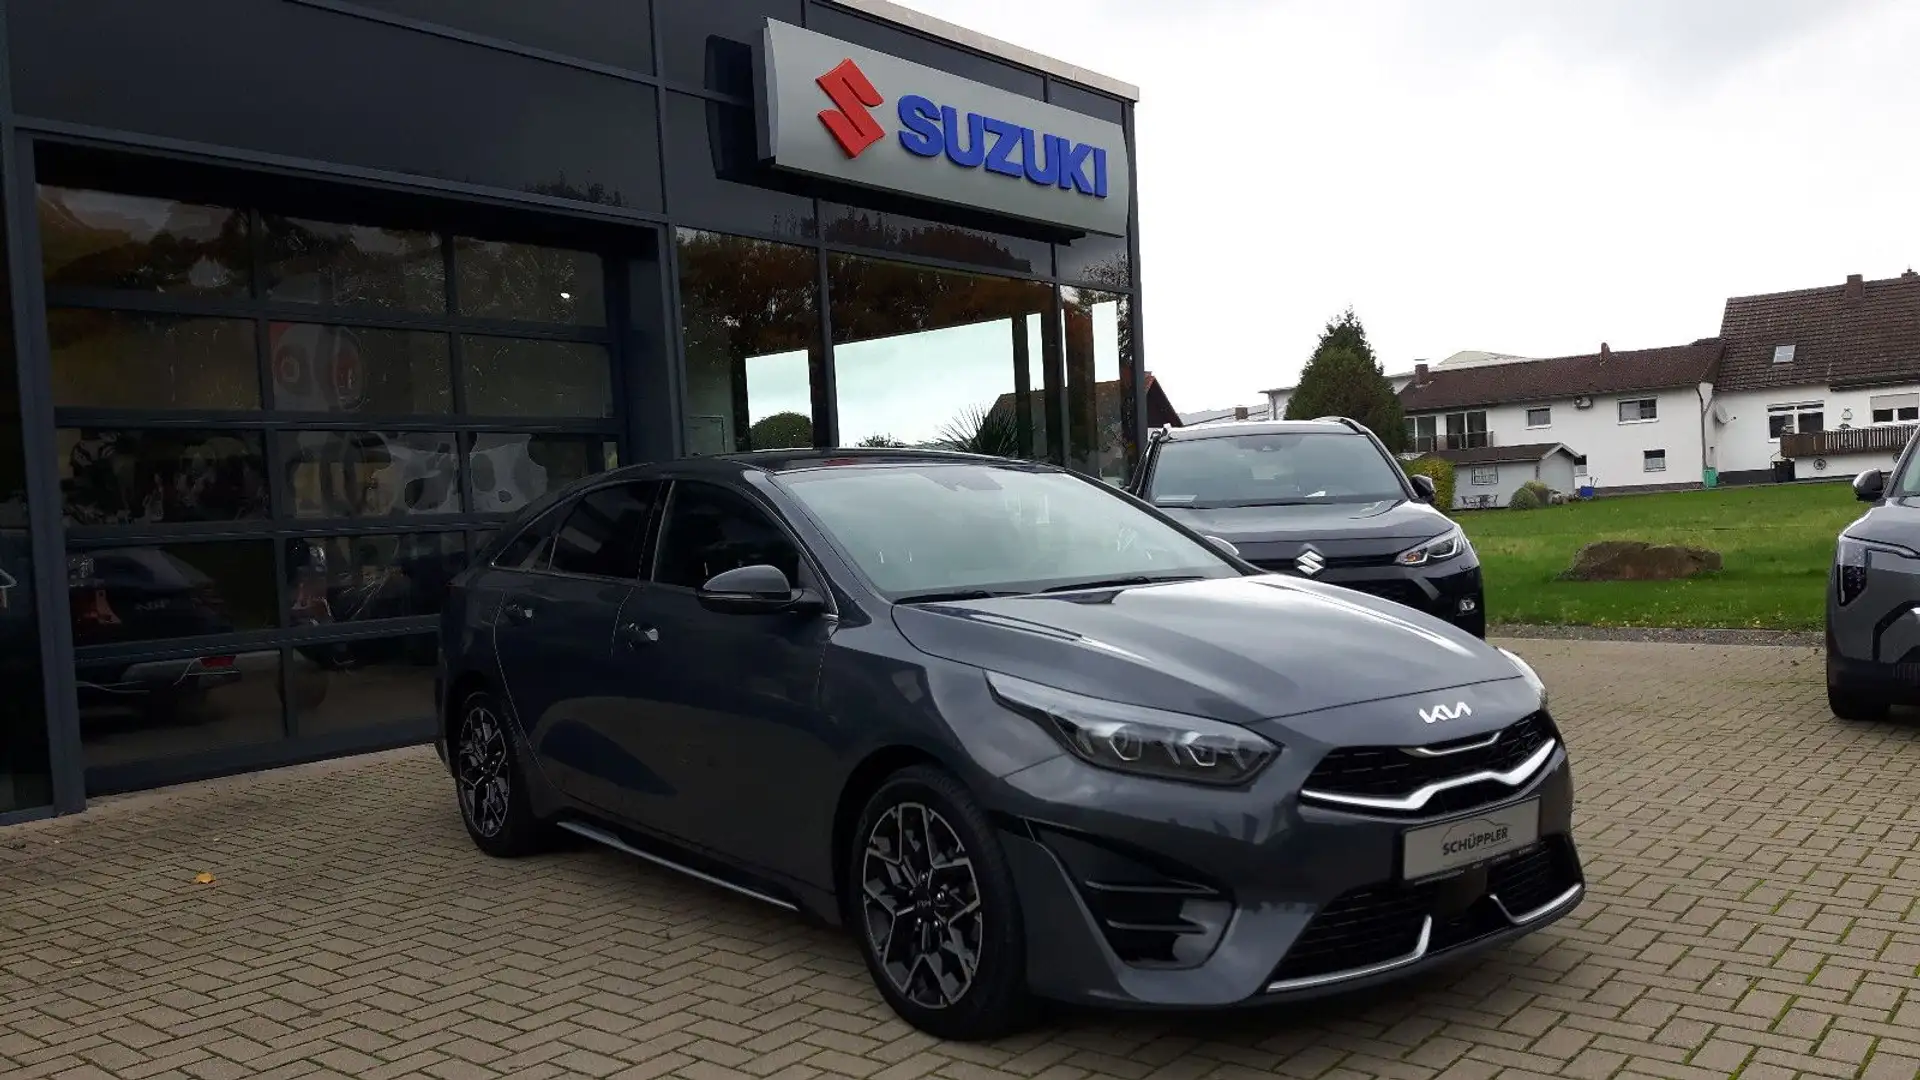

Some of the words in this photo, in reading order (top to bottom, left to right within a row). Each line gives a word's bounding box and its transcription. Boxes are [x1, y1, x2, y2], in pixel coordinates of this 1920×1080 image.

[897, 94, 1107, 197] SUZUKI
[1419, 702, 1472, 723] KIA
[1442, 826, 1508, 856] SCHÜPPLER
